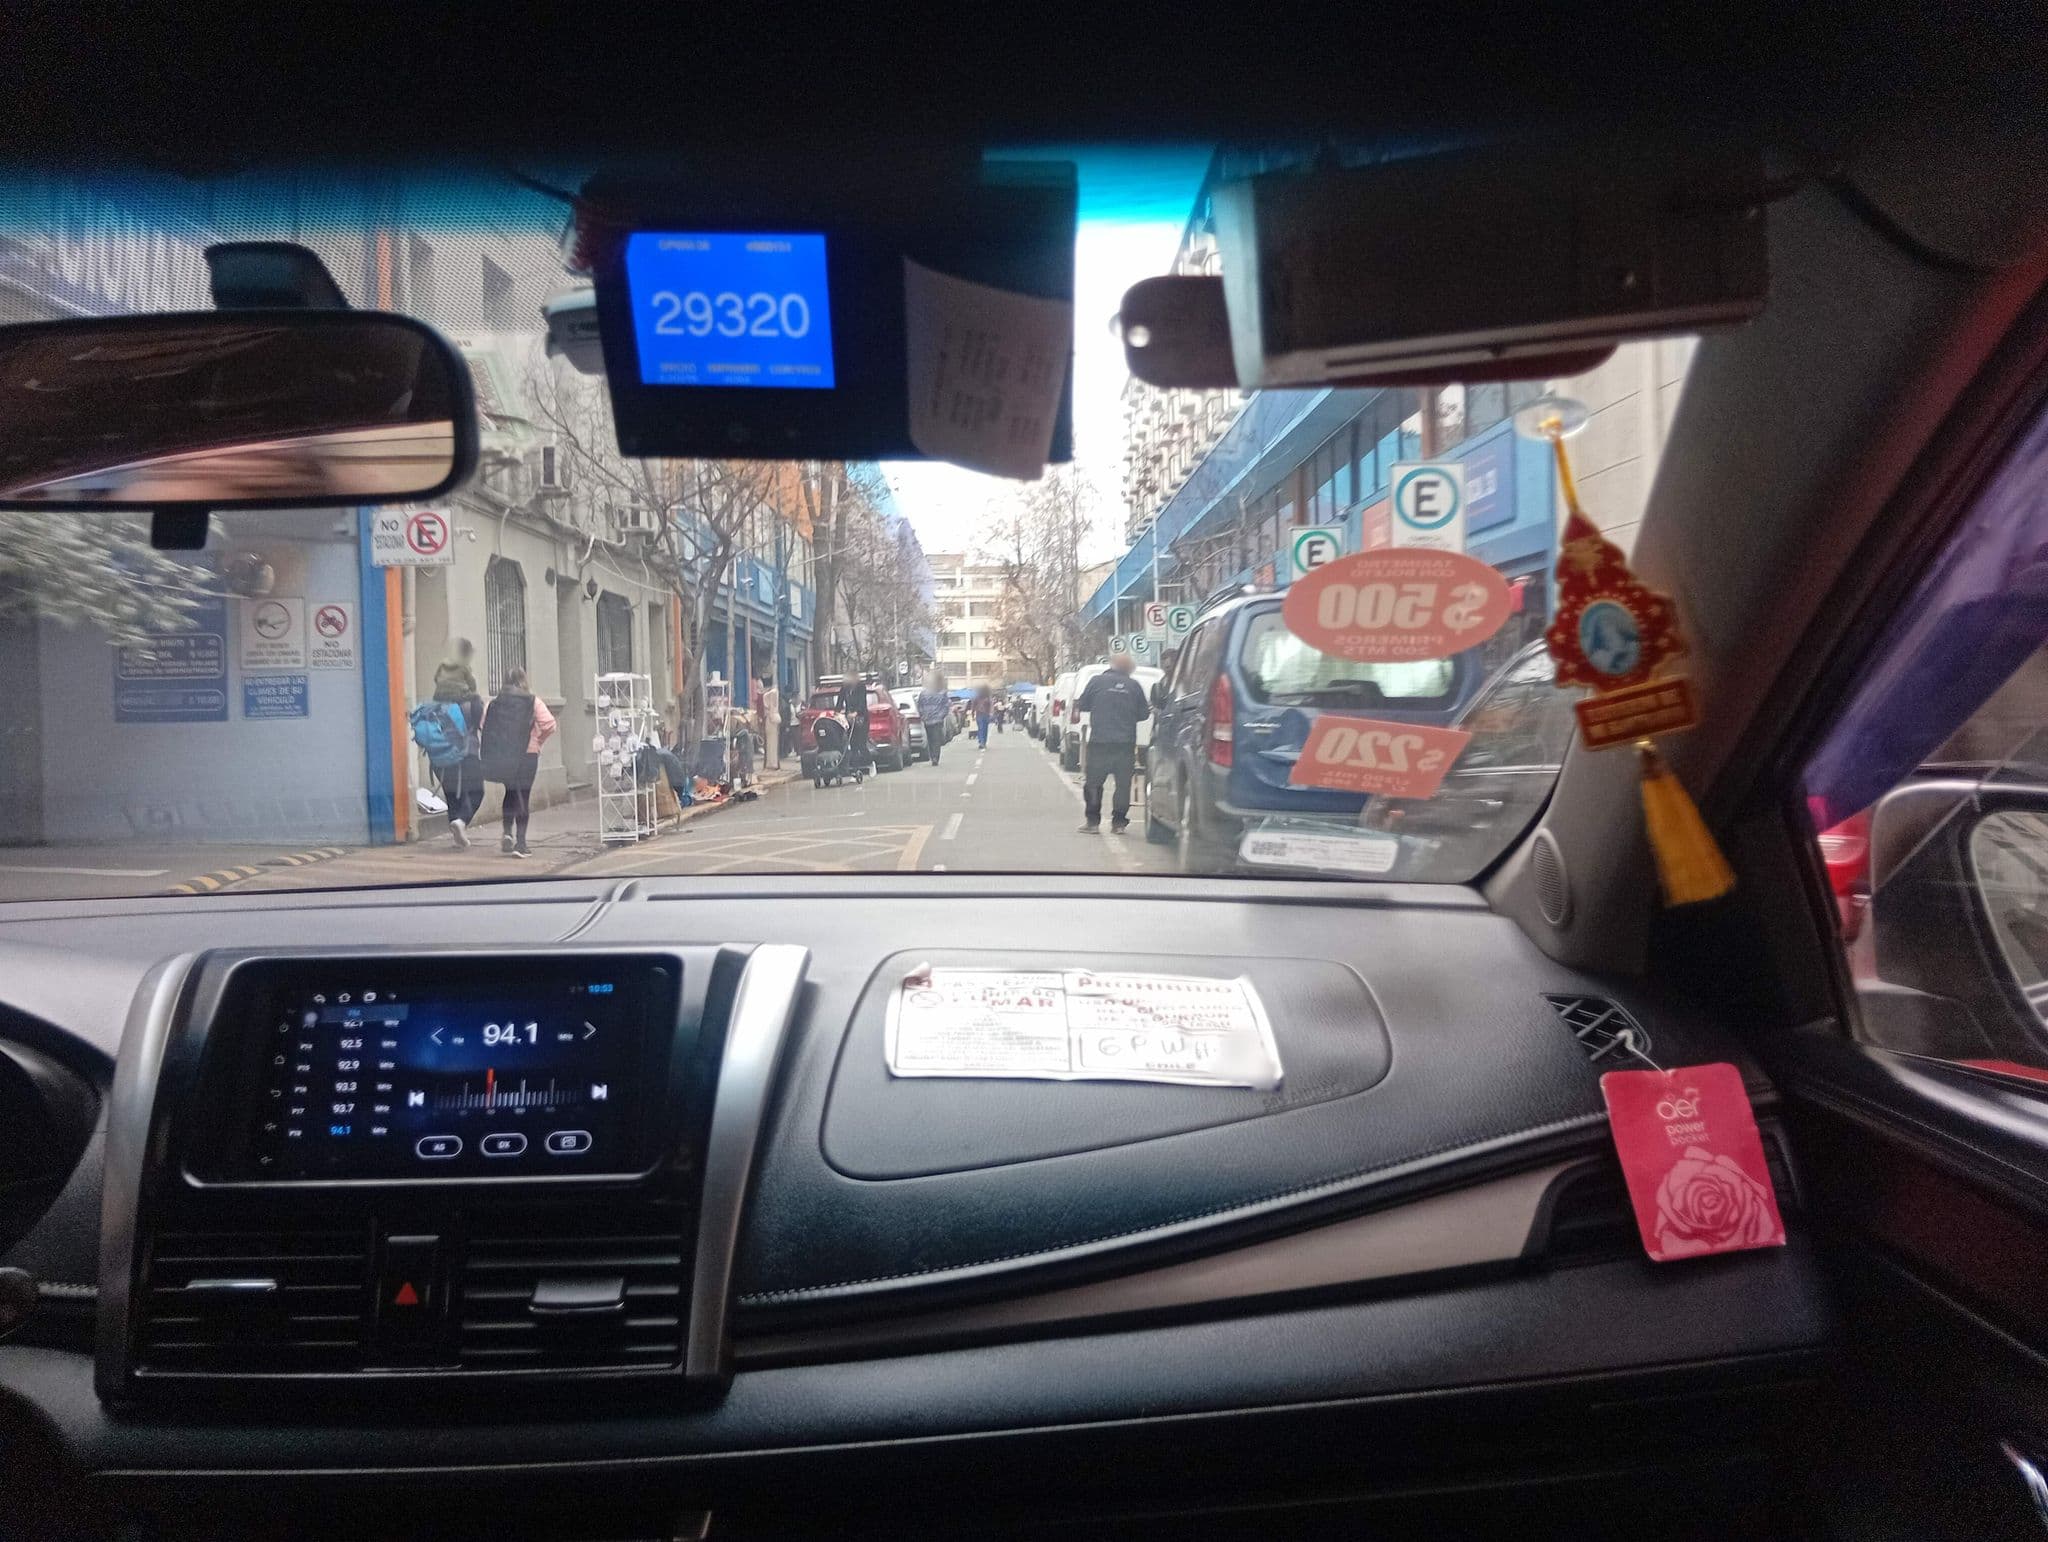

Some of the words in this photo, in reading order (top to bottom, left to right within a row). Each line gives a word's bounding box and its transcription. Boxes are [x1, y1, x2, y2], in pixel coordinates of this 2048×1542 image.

[652, 290, 810, 339] 29320
[1414, 480, 1440, 517] E
[381, 519, 399, 531] NO
[1308, 540, 1326, 568] E
[1176, 612, 1187, 628] E
[1114, 641, 1122, 651] E
[1136, 638, 1144, 650] E
[483, 1022, 538, 1046] 94.1
[340, 1039, 363, 1048] 92.5
[337, 1061, 360, 1070] 92.9
[335, 1082, 358, 1092] 93.3
[332, 1103, 355, 1114] 93.7
[329, 1126, 351, 1136] 94.1
[1664, 1120, 1704, 1137] power
